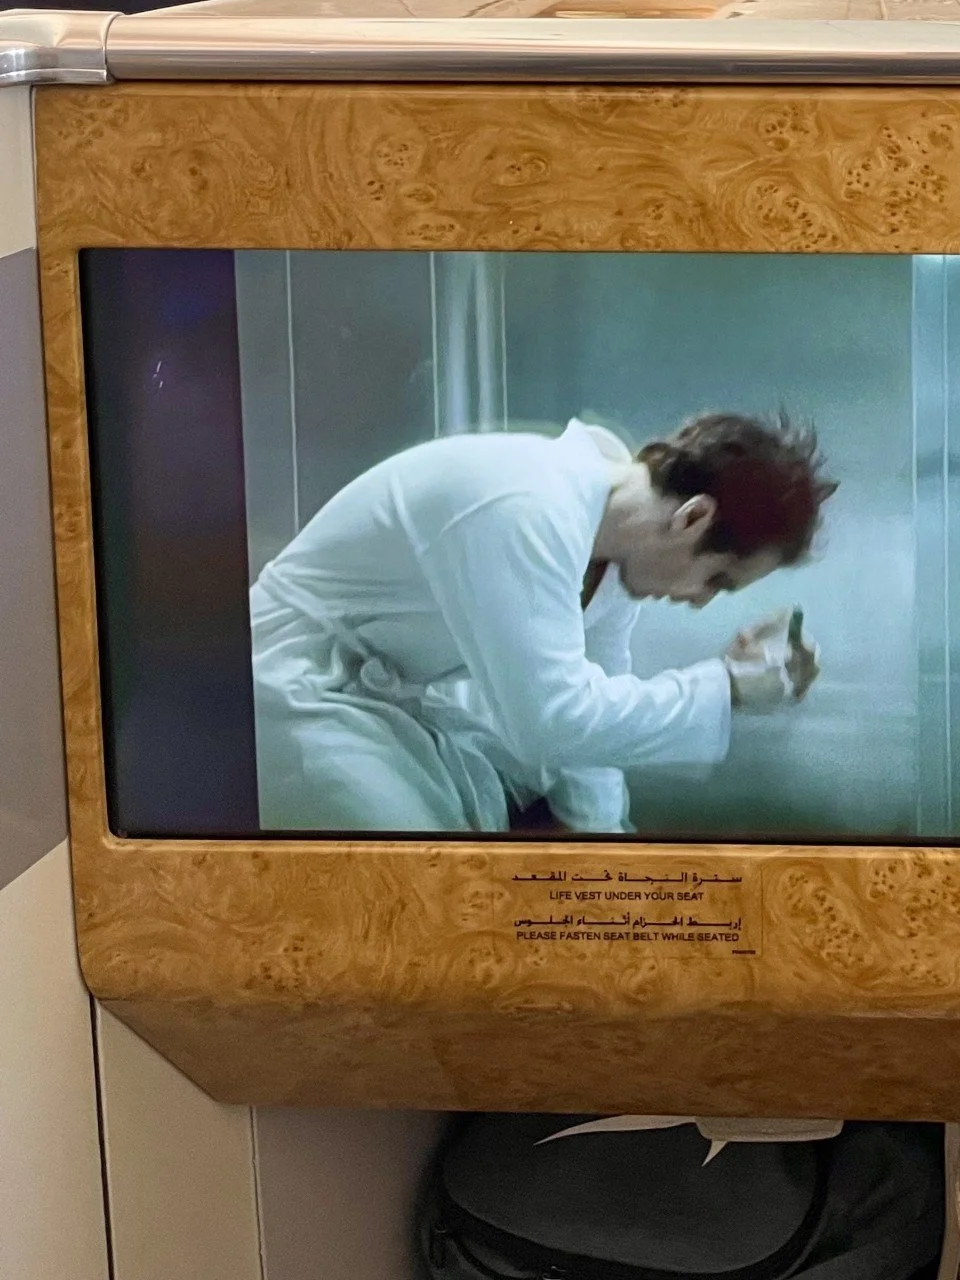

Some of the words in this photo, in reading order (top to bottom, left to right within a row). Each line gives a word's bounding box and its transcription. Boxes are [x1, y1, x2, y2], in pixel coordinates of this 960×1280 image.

[549, 891, 572, 900] LIFE
[574, 891, 602, 901] VEST
[604, 891, 642, 901] UNDER
[644, 891, 675, 901] YOUR
[676, 892, 704, 901] SEAT
[516, 931, 557, 941] PLEASE
[559, 931, 601, 941] FASTEN
[603, 931, 631, 941] SEAT
[632, 932, 660, 941] BELT
[662, 932, 695, 941] WHILE
[696, 932, 740, 942] SEATED
